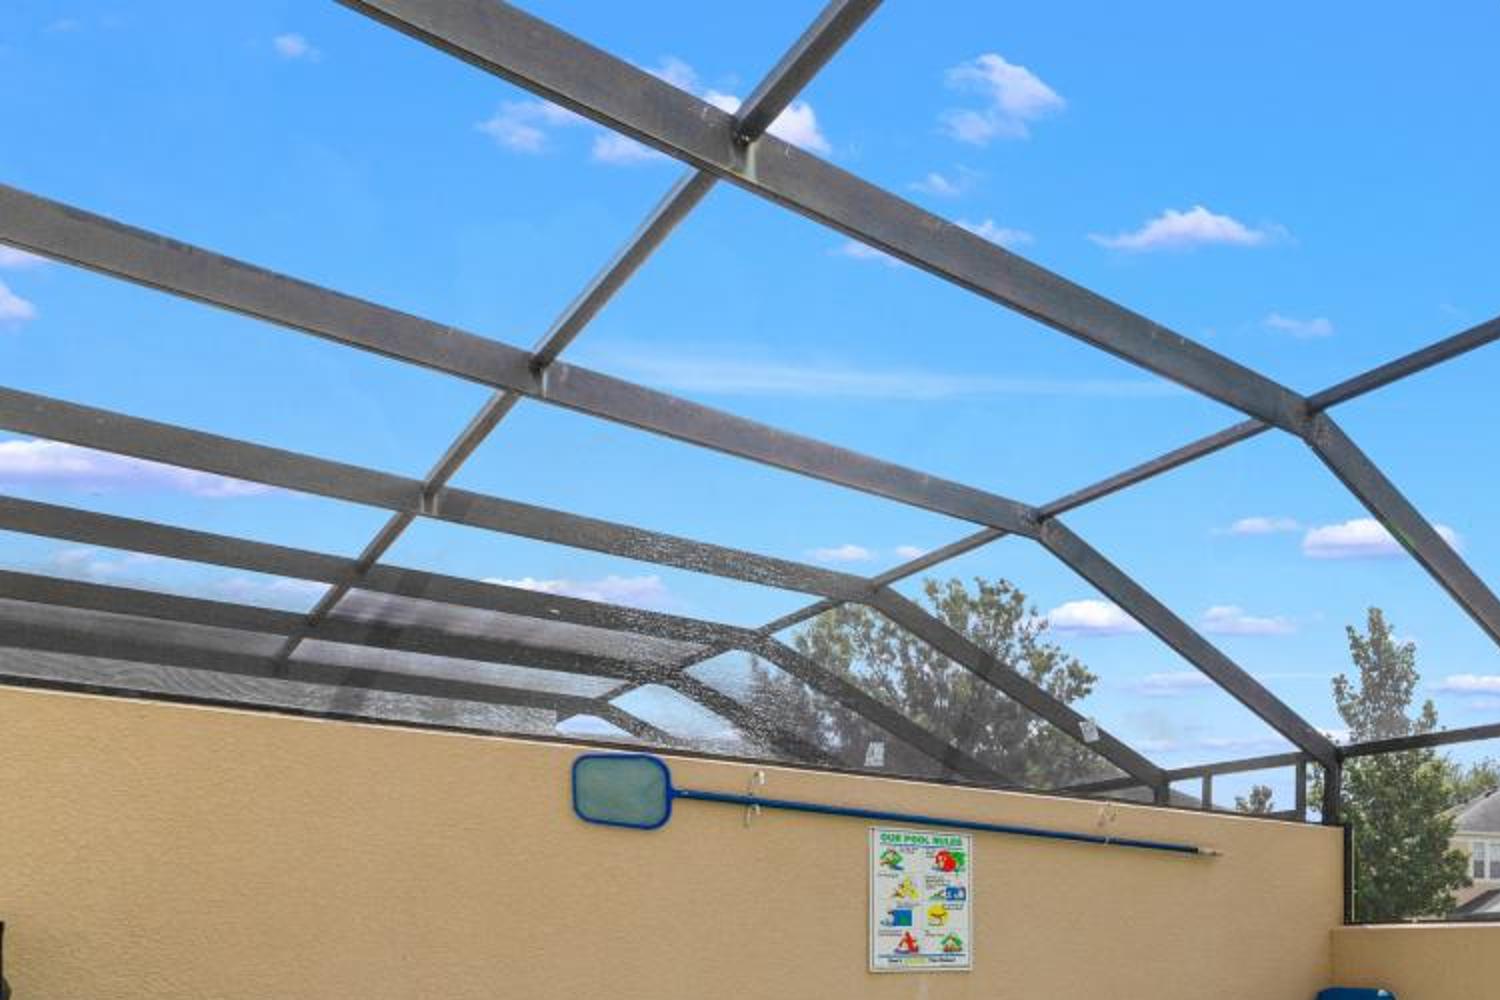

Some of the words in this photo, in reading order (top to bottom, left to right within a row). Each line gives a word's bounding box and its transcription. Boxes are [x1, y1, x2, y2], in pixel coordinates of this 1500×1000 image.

[880, 833, 900, 843] OUR
[904, 834, 929, 844] POOL
[932, 836, 962, 846] RULES
